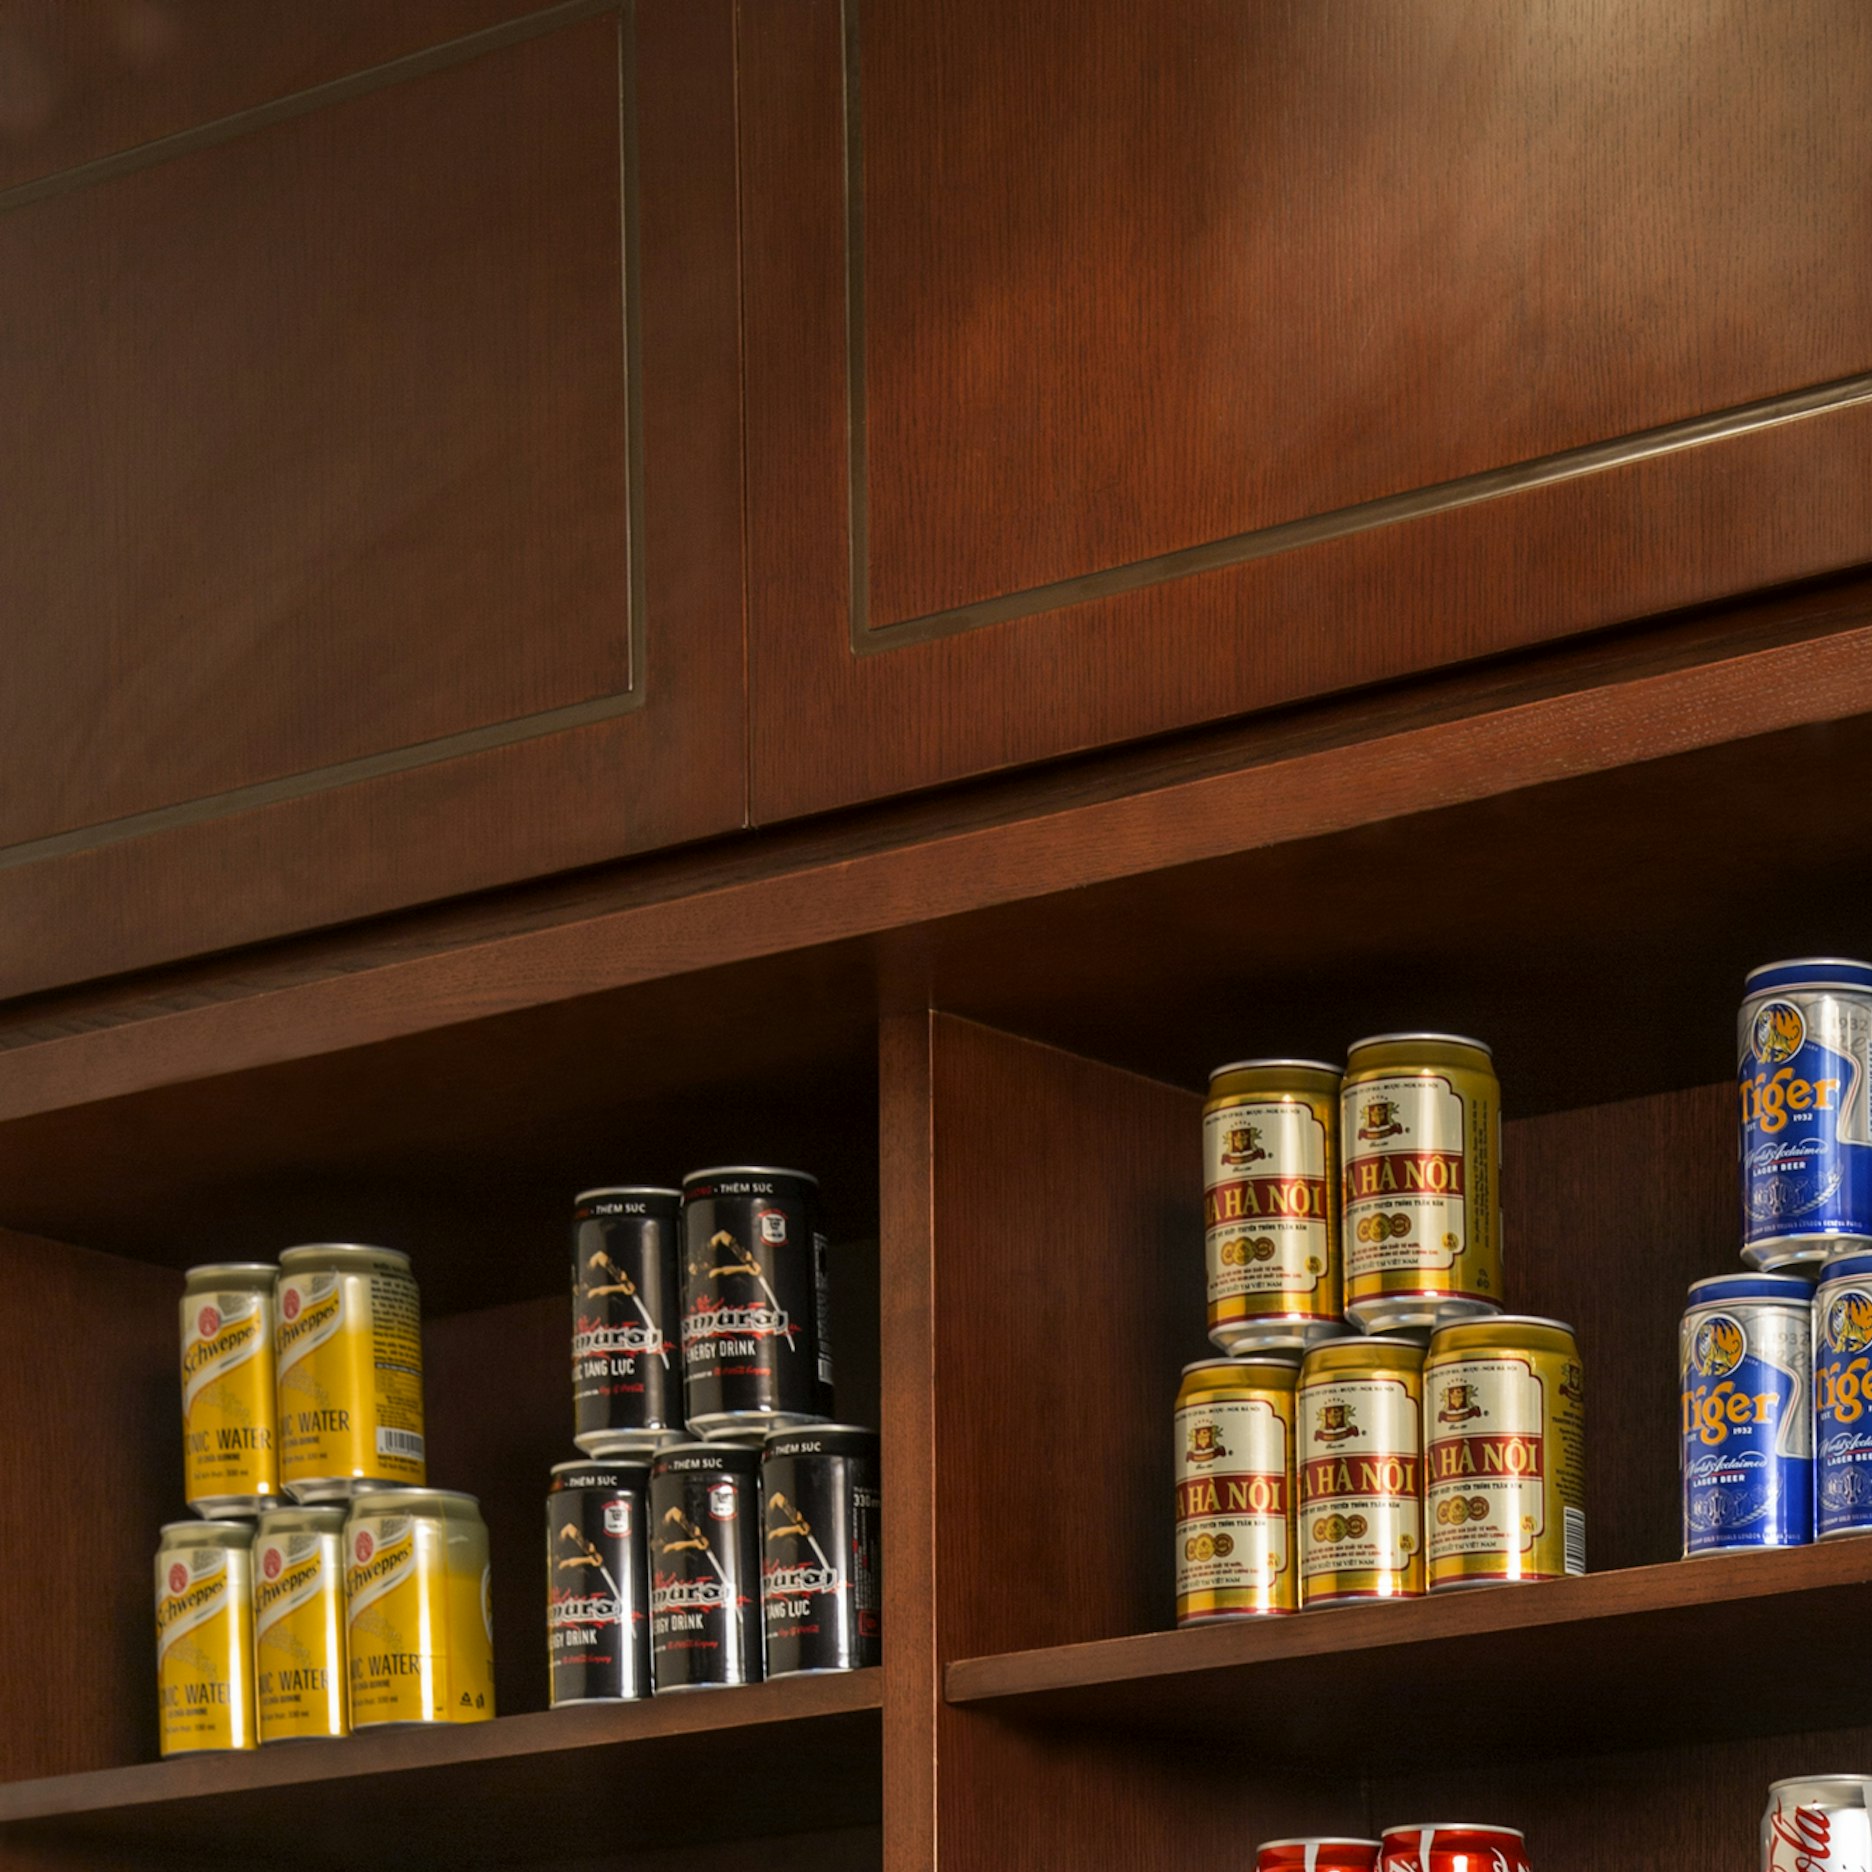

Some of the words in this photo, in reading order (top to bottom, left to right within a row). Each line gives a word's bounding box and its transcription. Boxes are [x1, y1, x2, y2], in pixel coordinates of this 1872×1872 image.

[1739, 1067, 1840, 1134] Tiger
[1361, 1157, 1399, 1193] HÀ
[1404, 1153, 1459, 1190] NỘI
[1754, 1164, 1776, 1175] LAGER
[1780, 1160, 1806, 1171] BEER
[1225, 1180, 1261, 1216] HÀ
[1267, 1175, 1322, 1215] NỘI
[719, 1340, 756, 1357] DRINK
[217, 1428, 271, 1450] WATER
